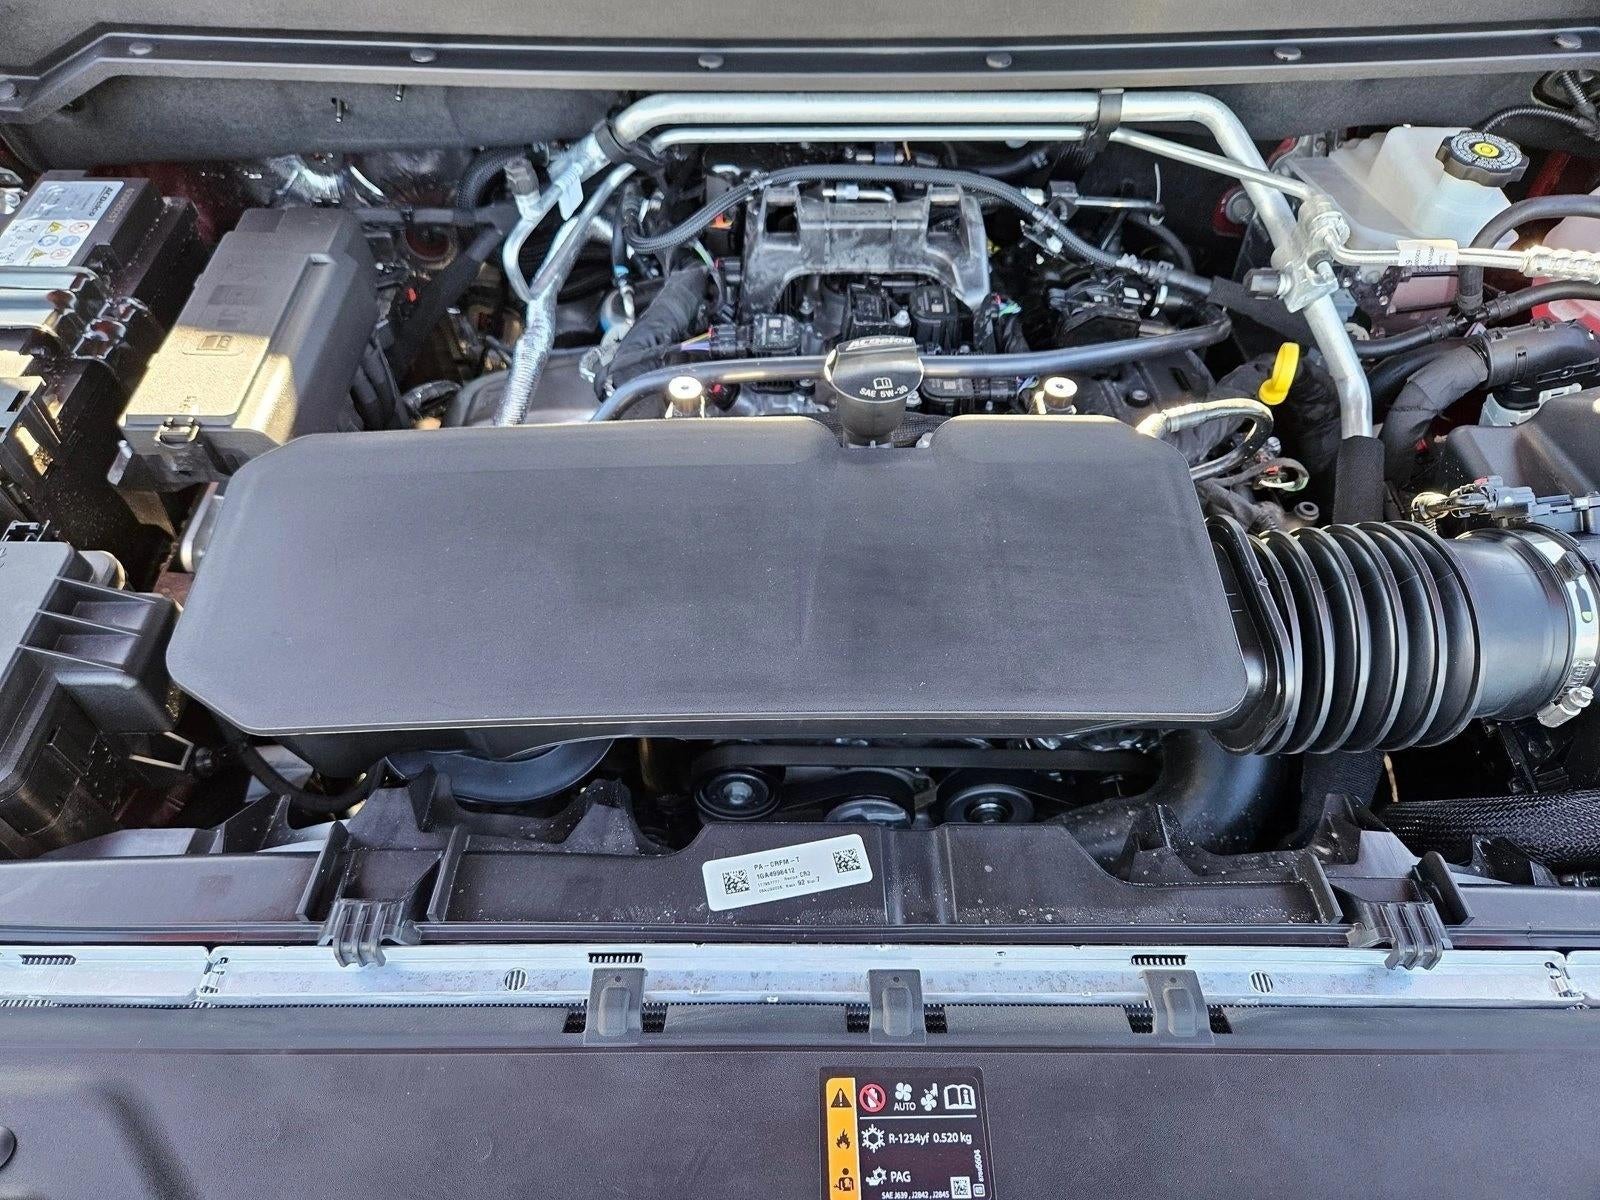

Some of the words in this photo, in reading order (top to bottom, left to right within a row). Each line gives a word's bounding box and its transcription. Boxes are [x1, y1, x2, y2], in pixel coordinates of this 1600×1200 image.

[89, 186, 114, 217] ACDelco
[859, 387, 877, 398] SAE
[880, 385, 909, 398] 5W-30
[893, 1102, 917, 1111] AUTO
[888, 1132, 930, 1146] R-1234yf
[932, 1132, 959, 1144] 0.520
[960, 1132, 973, 1145] kg
[890, 1171, 912, 1183] PAG
[881, 1191, 894, 1200] SAE
